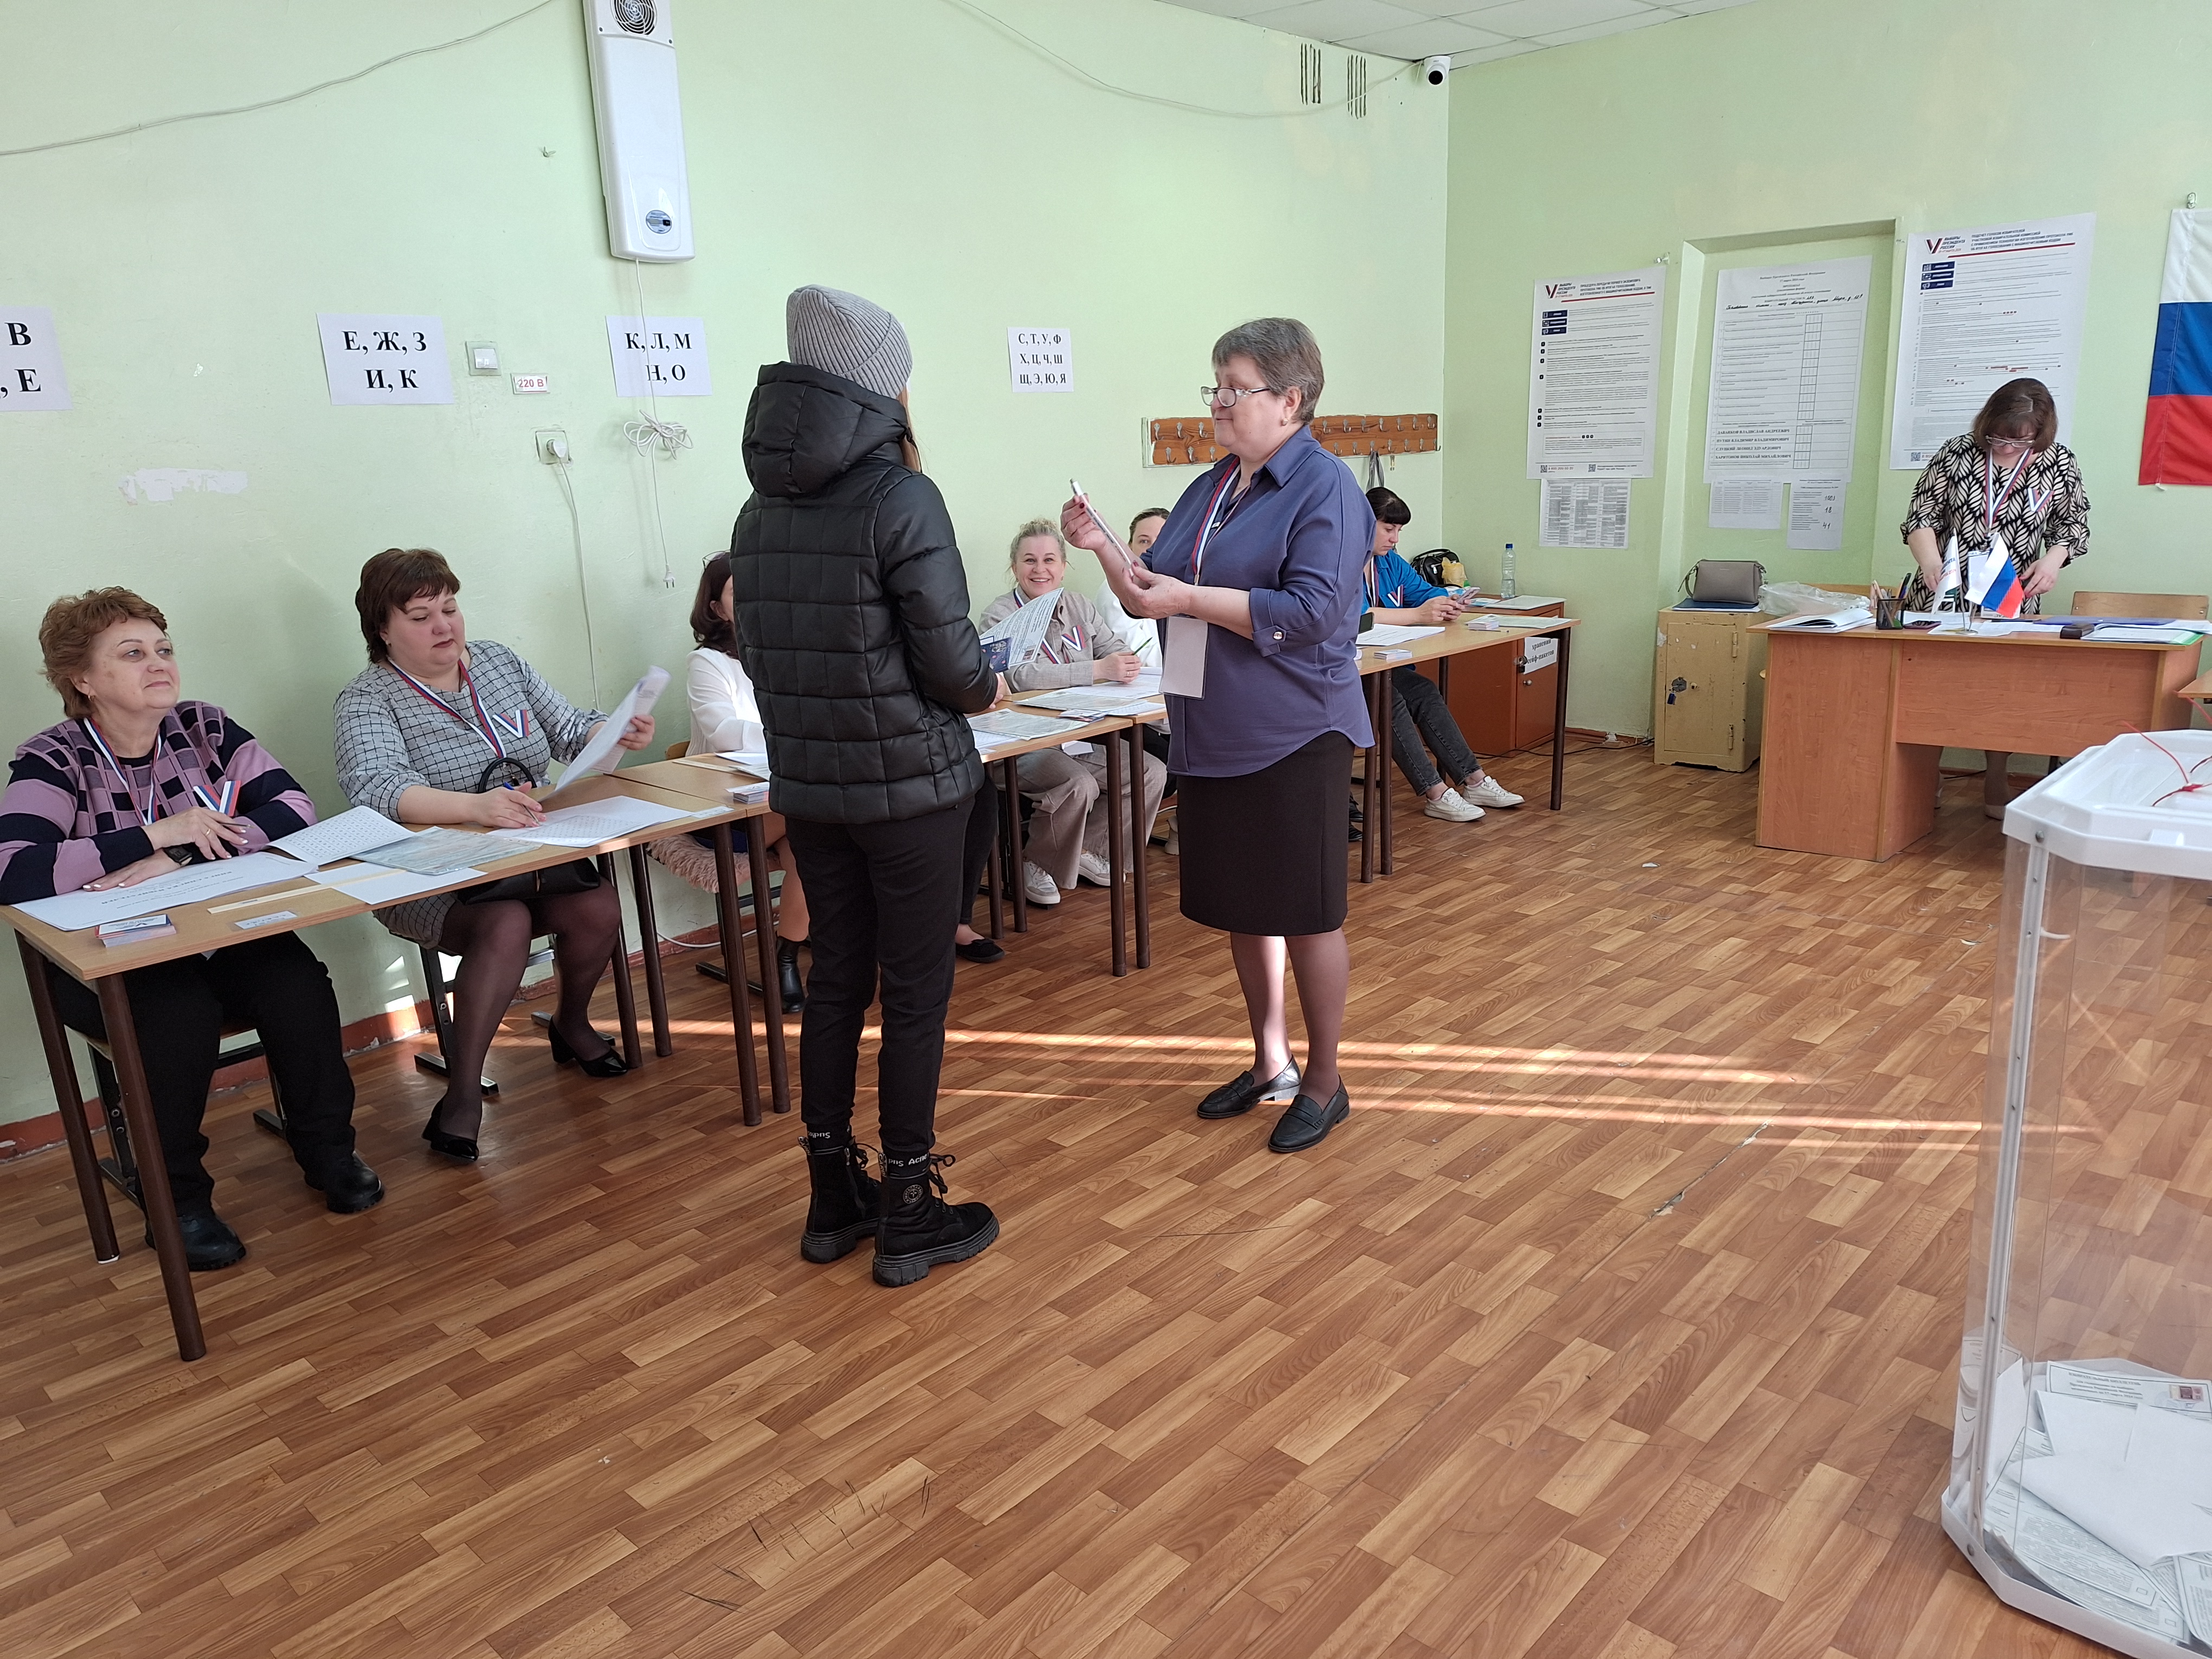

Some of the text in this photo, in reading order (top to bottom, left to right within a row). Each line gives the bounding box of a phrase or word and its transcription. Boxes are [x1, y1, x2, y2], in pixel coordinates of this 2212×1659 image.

[4, 323, 31, 345] В
[342, 331, 427, 355] Е, Ж, З
[624, 333, 692, 353] К, Л, М
[1053, 335, 1061, 344] Ф
[1053, 355, 1063, 364] Ш
[14, 369, 41, 392] Е
[364, 369, 419, 393] И, К
[518, 379, 534, 387] 220
[645, 364, 685, 384] Н, О
[1060, 374, 1066, 383] Я
